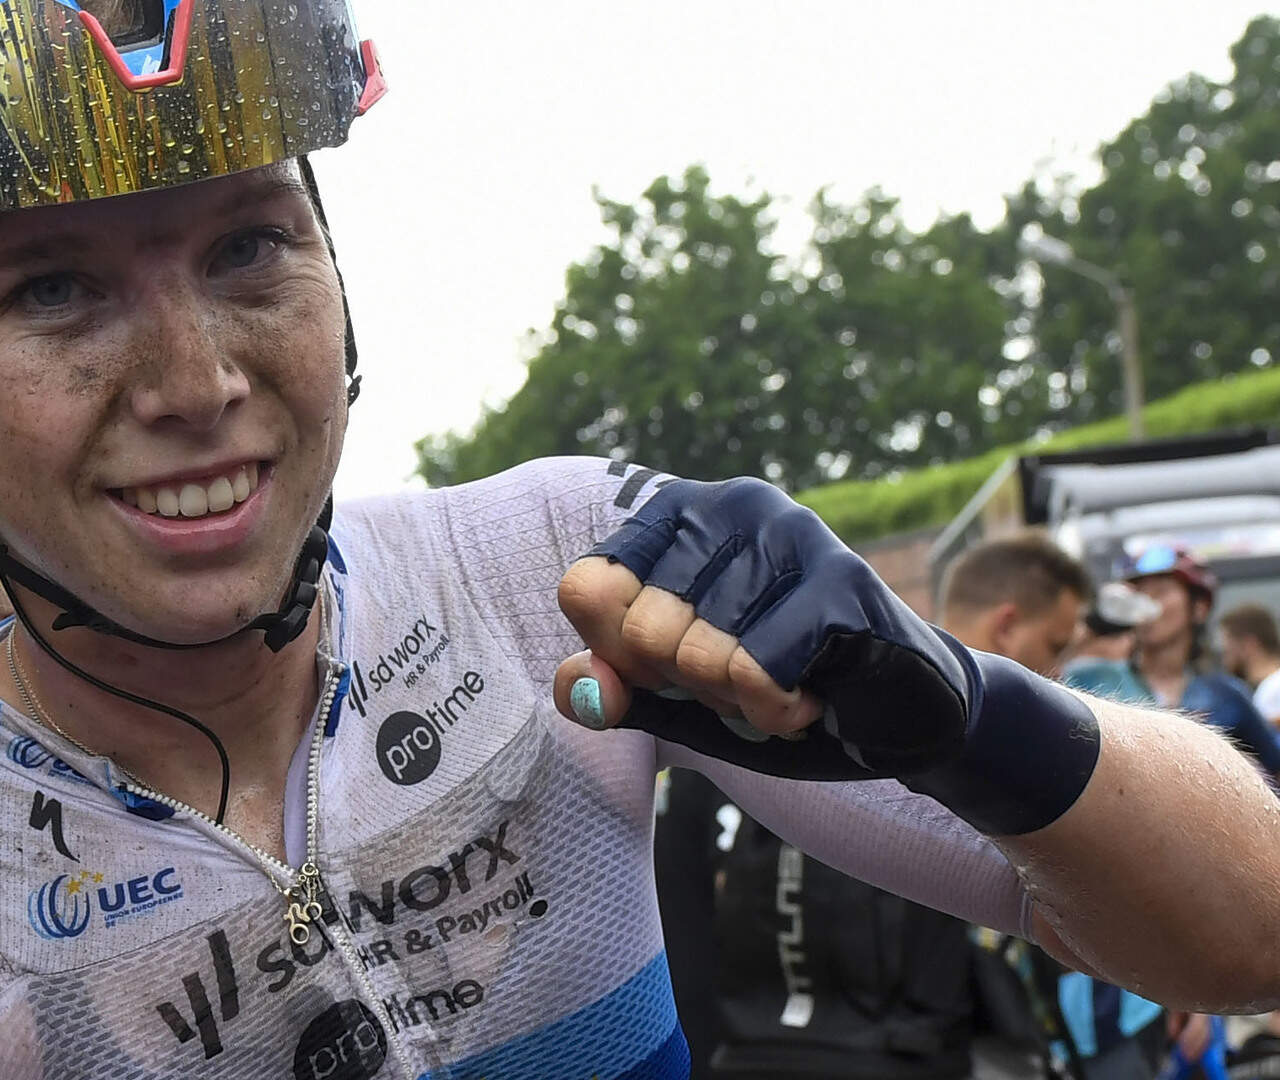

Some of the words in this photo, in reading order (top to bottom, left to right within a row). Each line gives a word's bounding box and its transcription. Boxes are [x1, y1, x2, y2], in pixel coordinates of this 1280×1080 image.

[422, 633, 451, 667] Payroll
[385, 670, 485, 780] protime
[97, 867, 182, 913] UEC
[404, 929, 432, 955] &
[435, 870, 535, 942] Payroll
